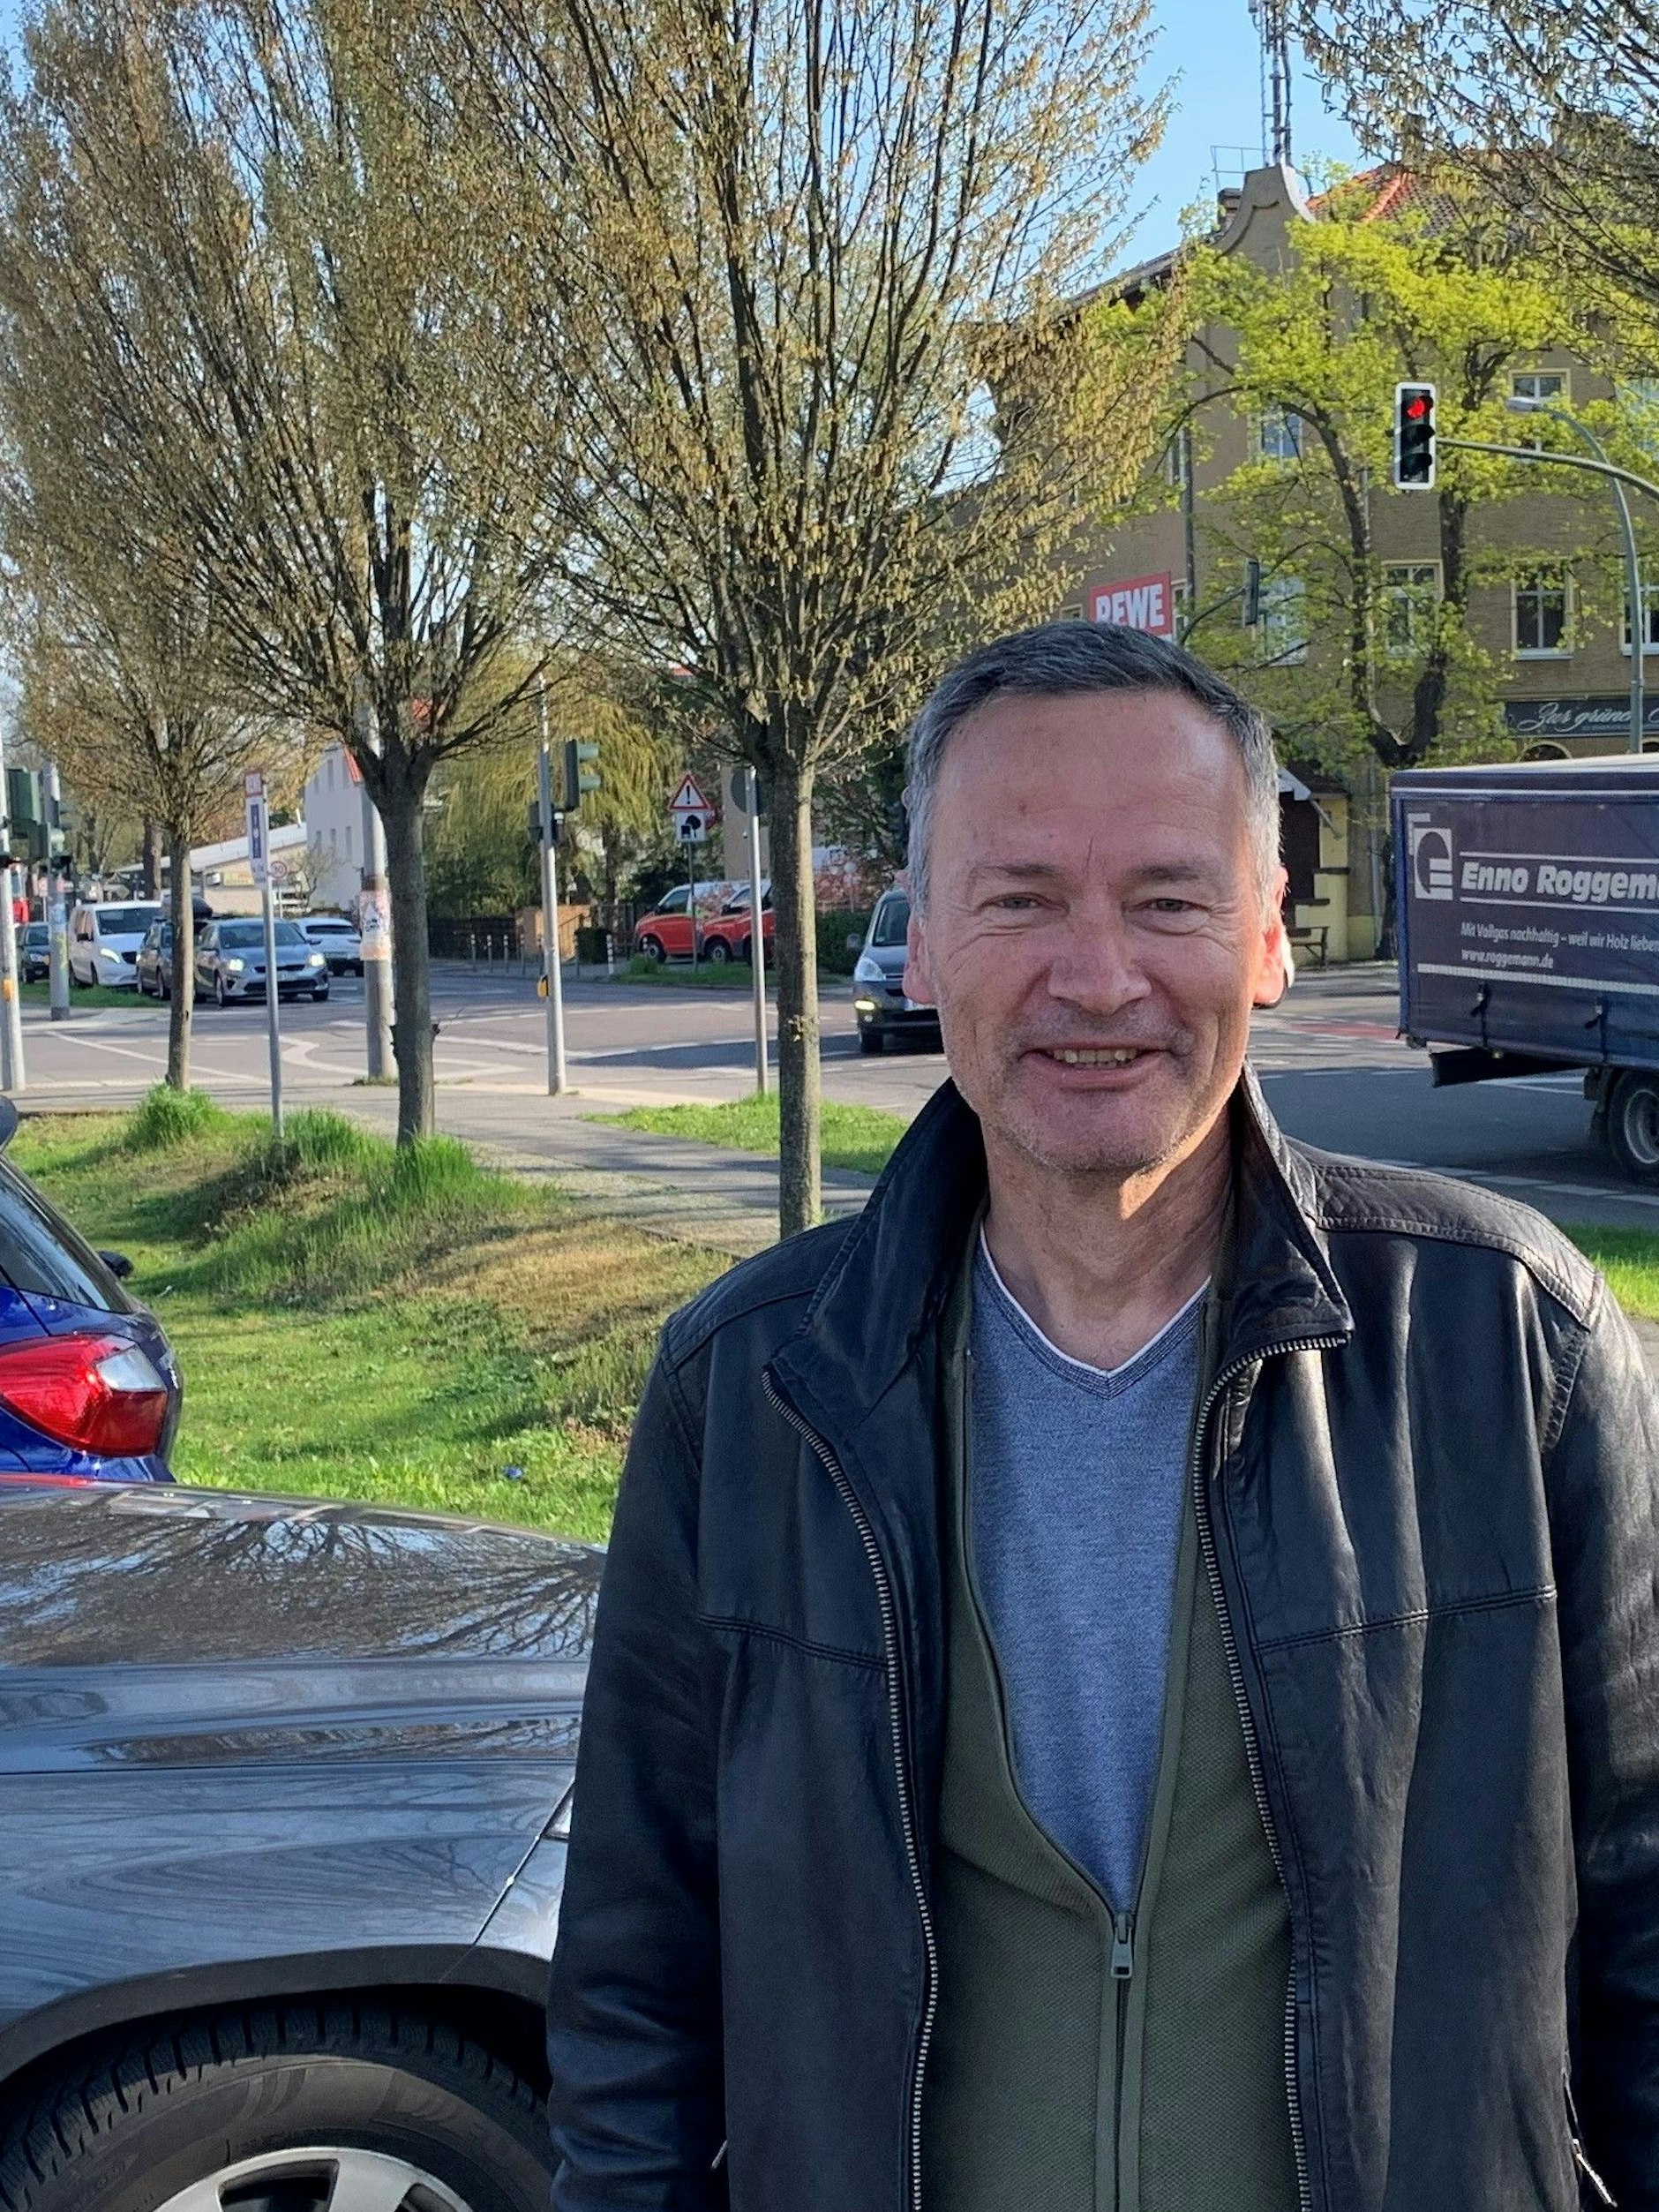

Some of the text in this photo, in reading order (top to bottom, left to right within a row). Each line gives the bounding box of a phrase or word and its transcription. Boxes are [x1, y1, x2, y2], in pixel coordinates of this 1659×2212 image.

[1096, 583, 1164, 629] REWE
[1554, 708, 1631, 733] grüne
[1461, 861, 1659, 903] Enno Roggem
[1461, 922, 1475, 937] Mit
[1510, 927, 1559, 948] nachhaltig
[1568, 931, 1588, 947] weil
[1589, 933, 1604, 948] wir
[1606, 933, 1629, 950] Holz
[1461, 949, 1554, 968] www.roggemann.de
